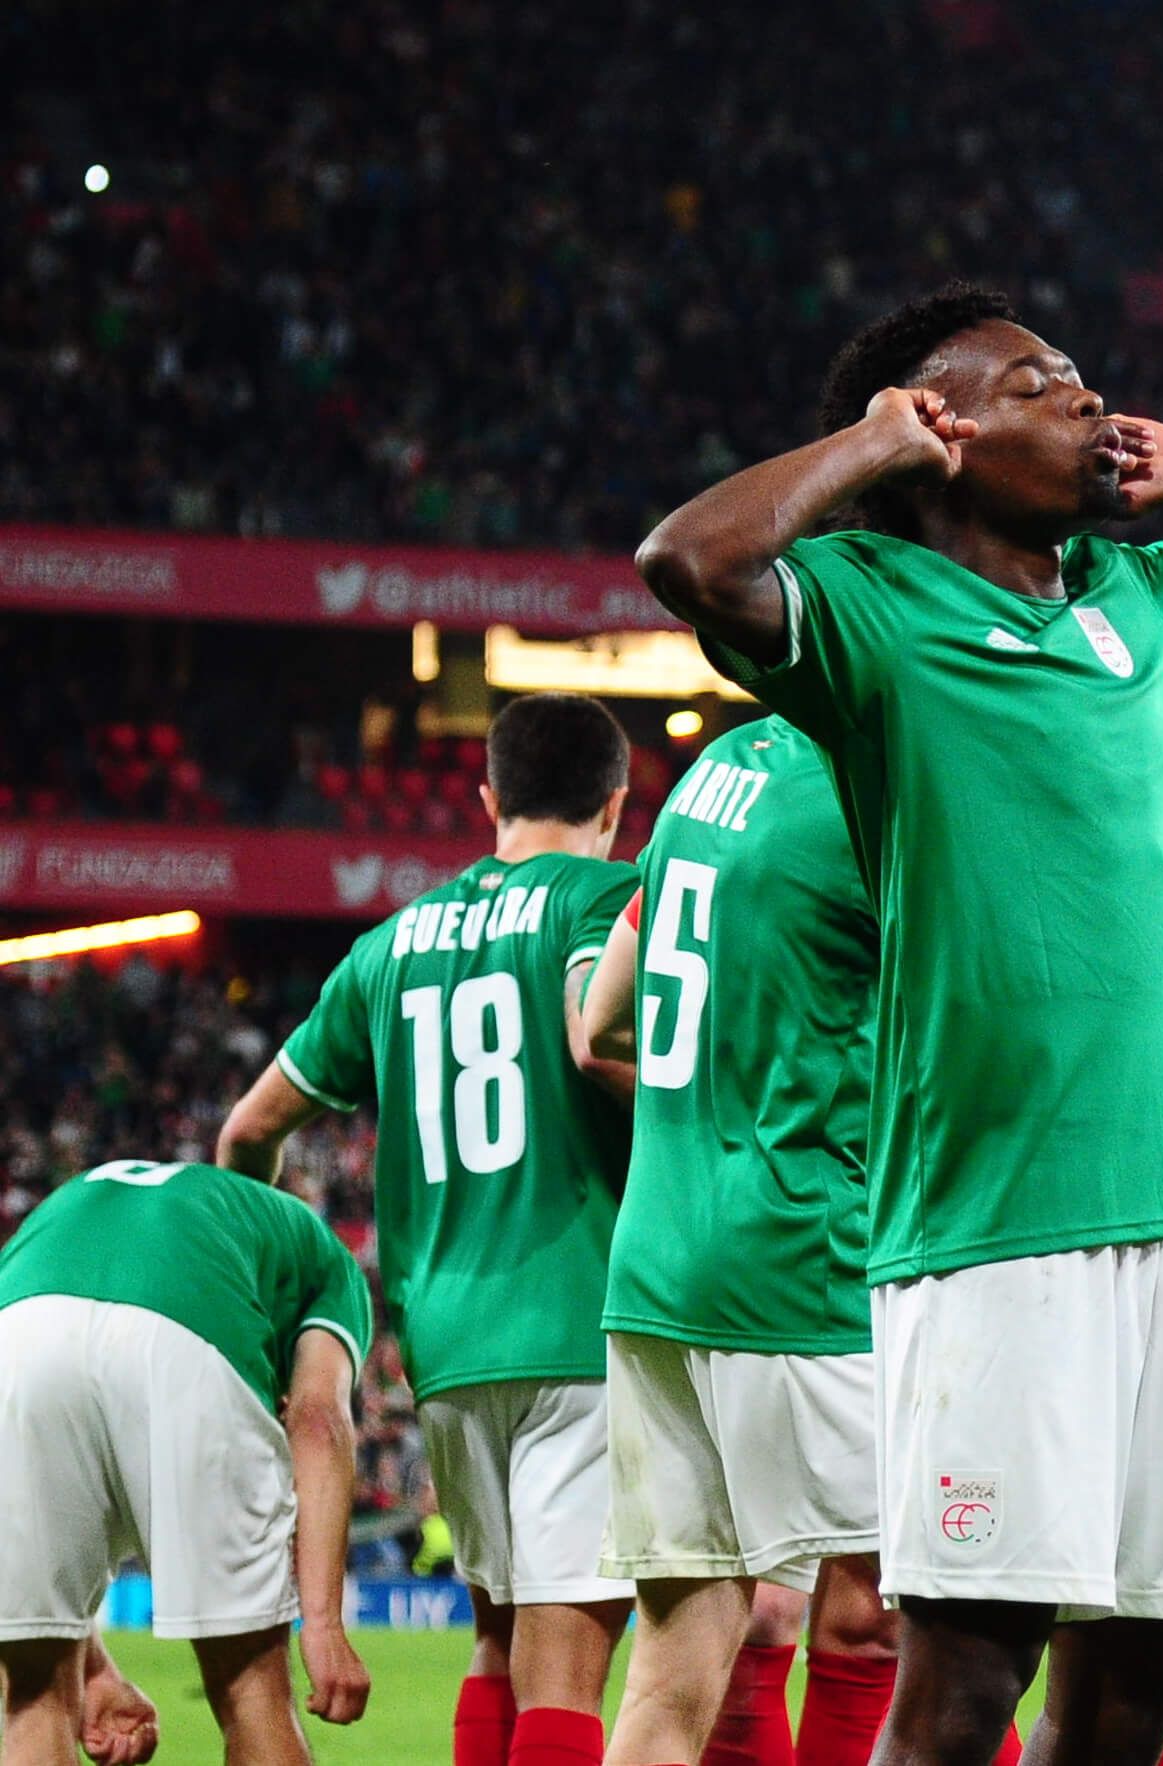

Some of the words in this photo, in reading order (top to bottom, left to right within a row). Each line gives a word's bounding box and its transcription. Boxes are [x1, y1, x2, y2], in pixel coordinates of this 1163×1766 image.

[670, 758, 769, 832] ARITZ
[401, 972, 526, 1184] 18
[640, 857, 718, 1089] 5
